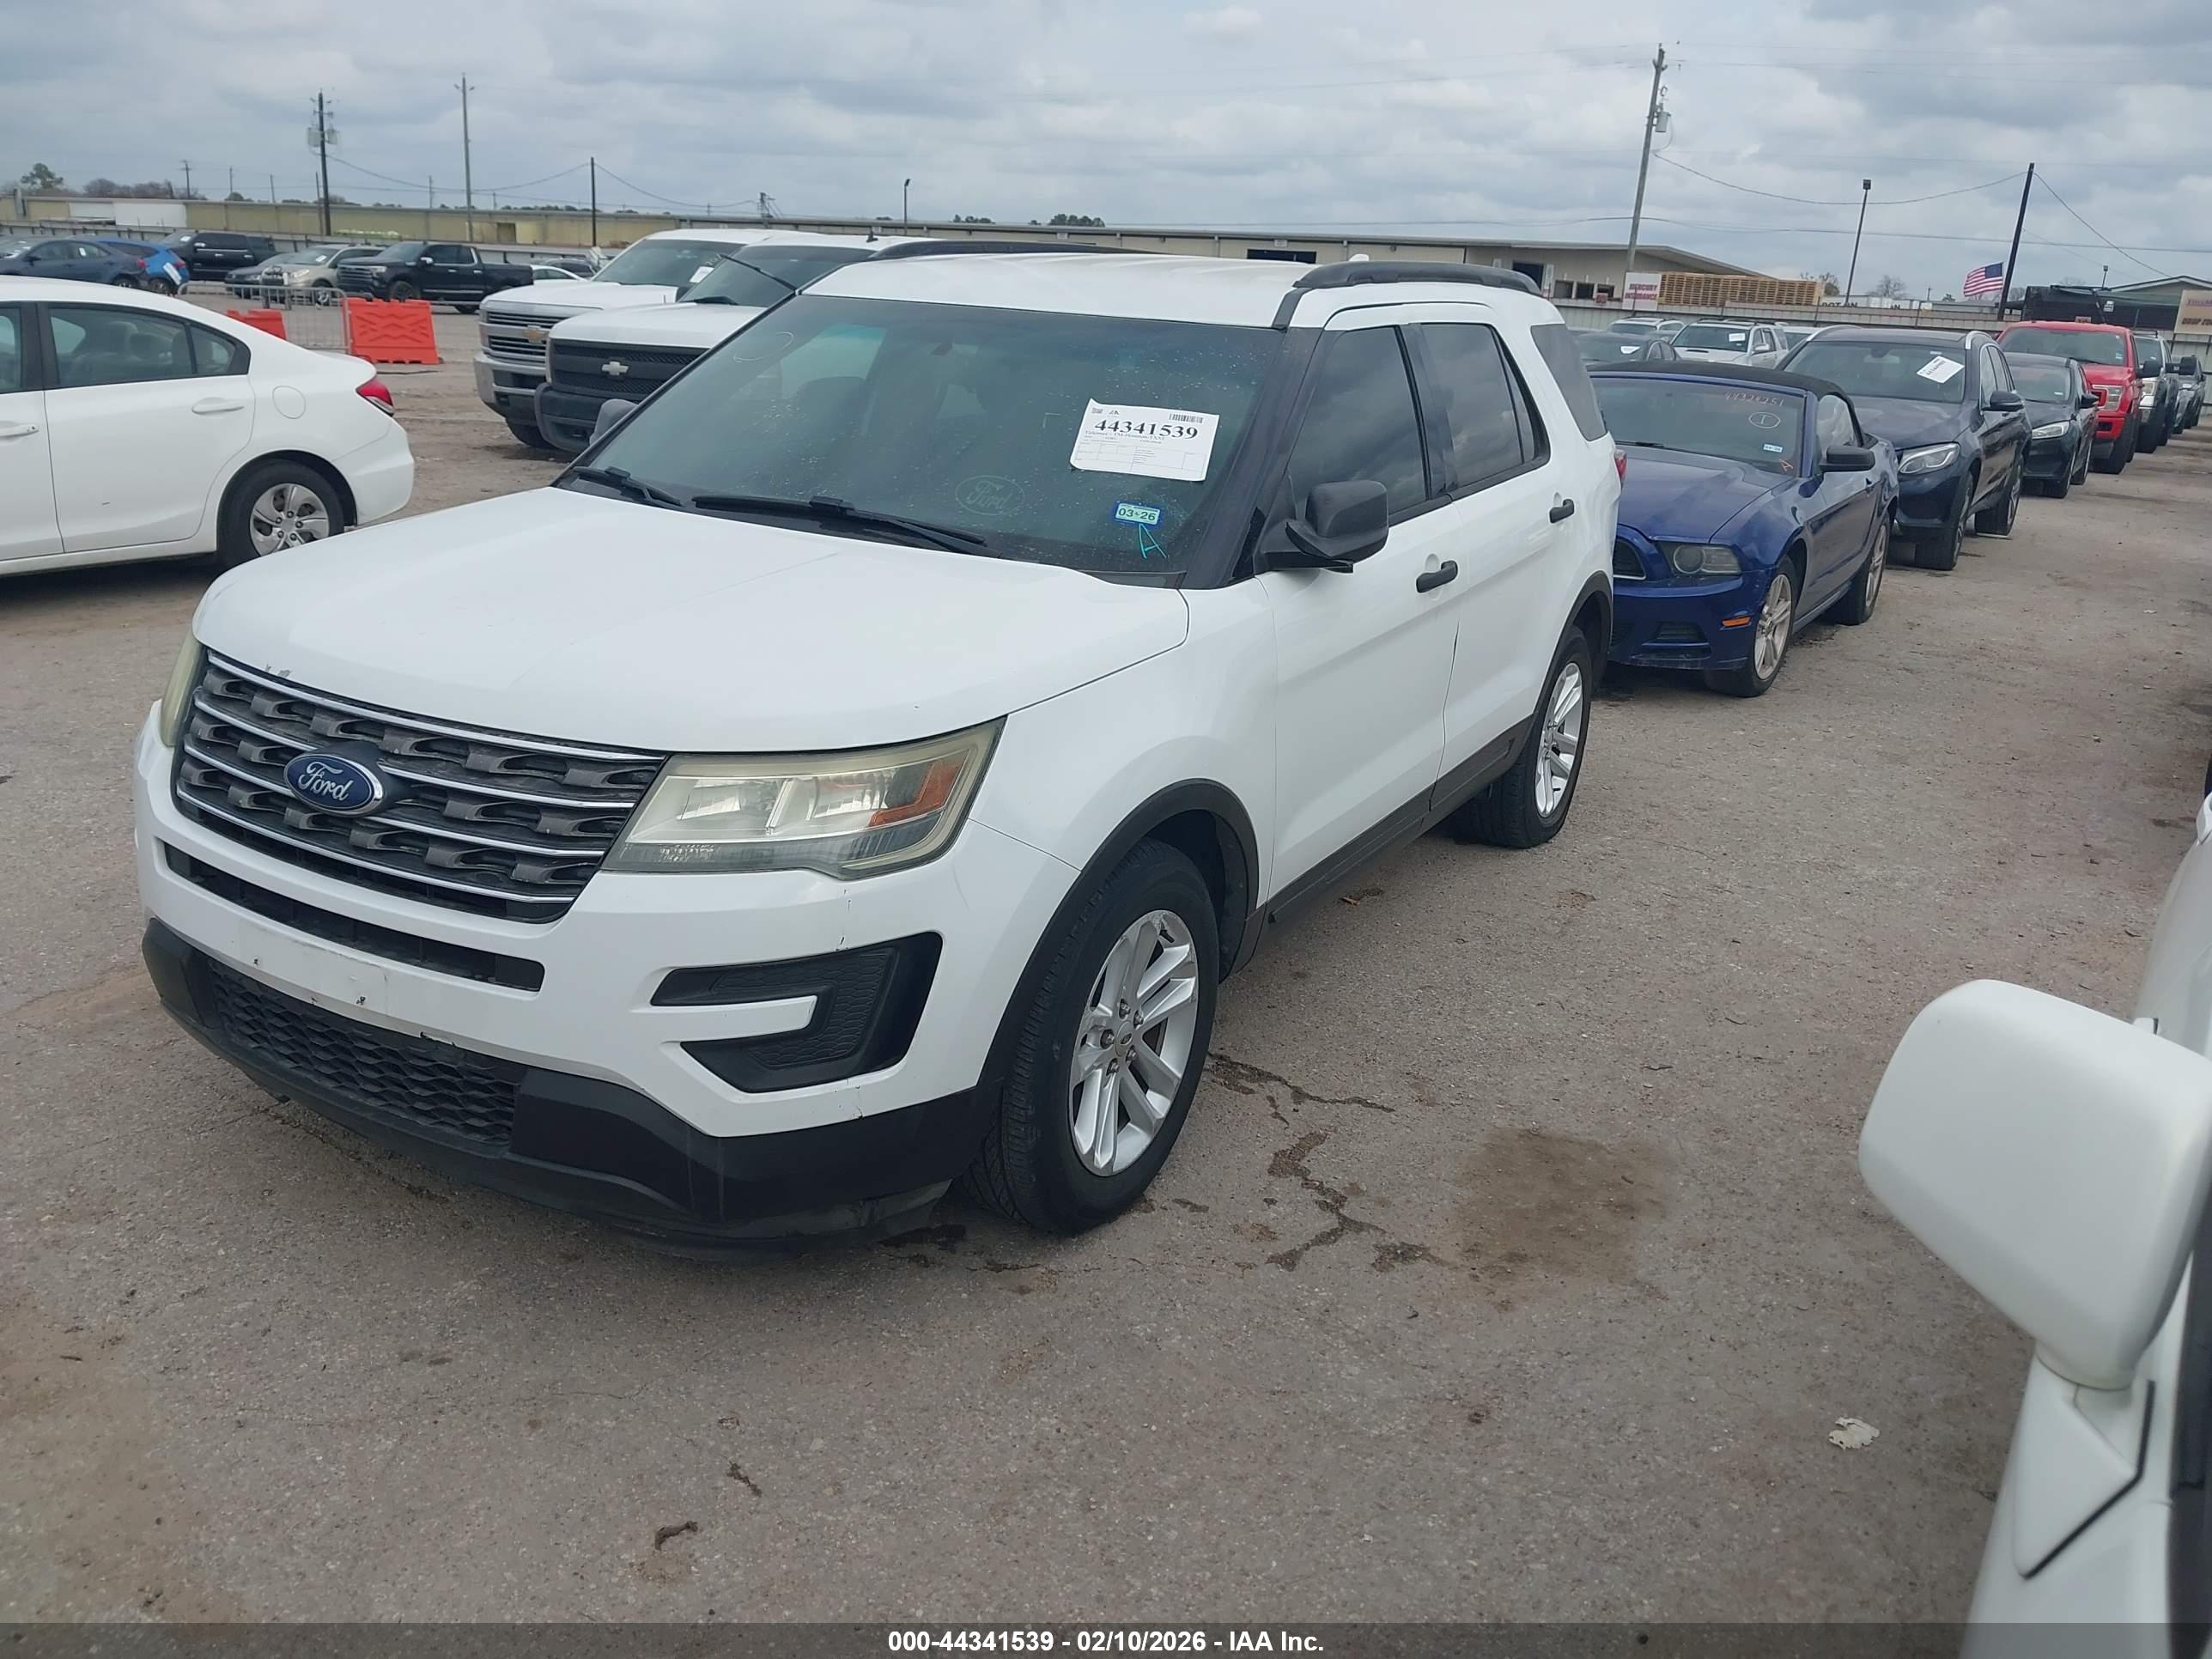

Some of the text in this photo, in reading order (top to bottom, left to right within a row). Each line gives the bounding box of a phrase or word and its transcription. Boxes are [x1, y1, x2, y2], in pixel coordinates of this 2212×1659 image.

[1095, 419, 1198, 440] 44341539
[1138, 523, 1167, 559] A
[297, 761, 355, 801] Ford
